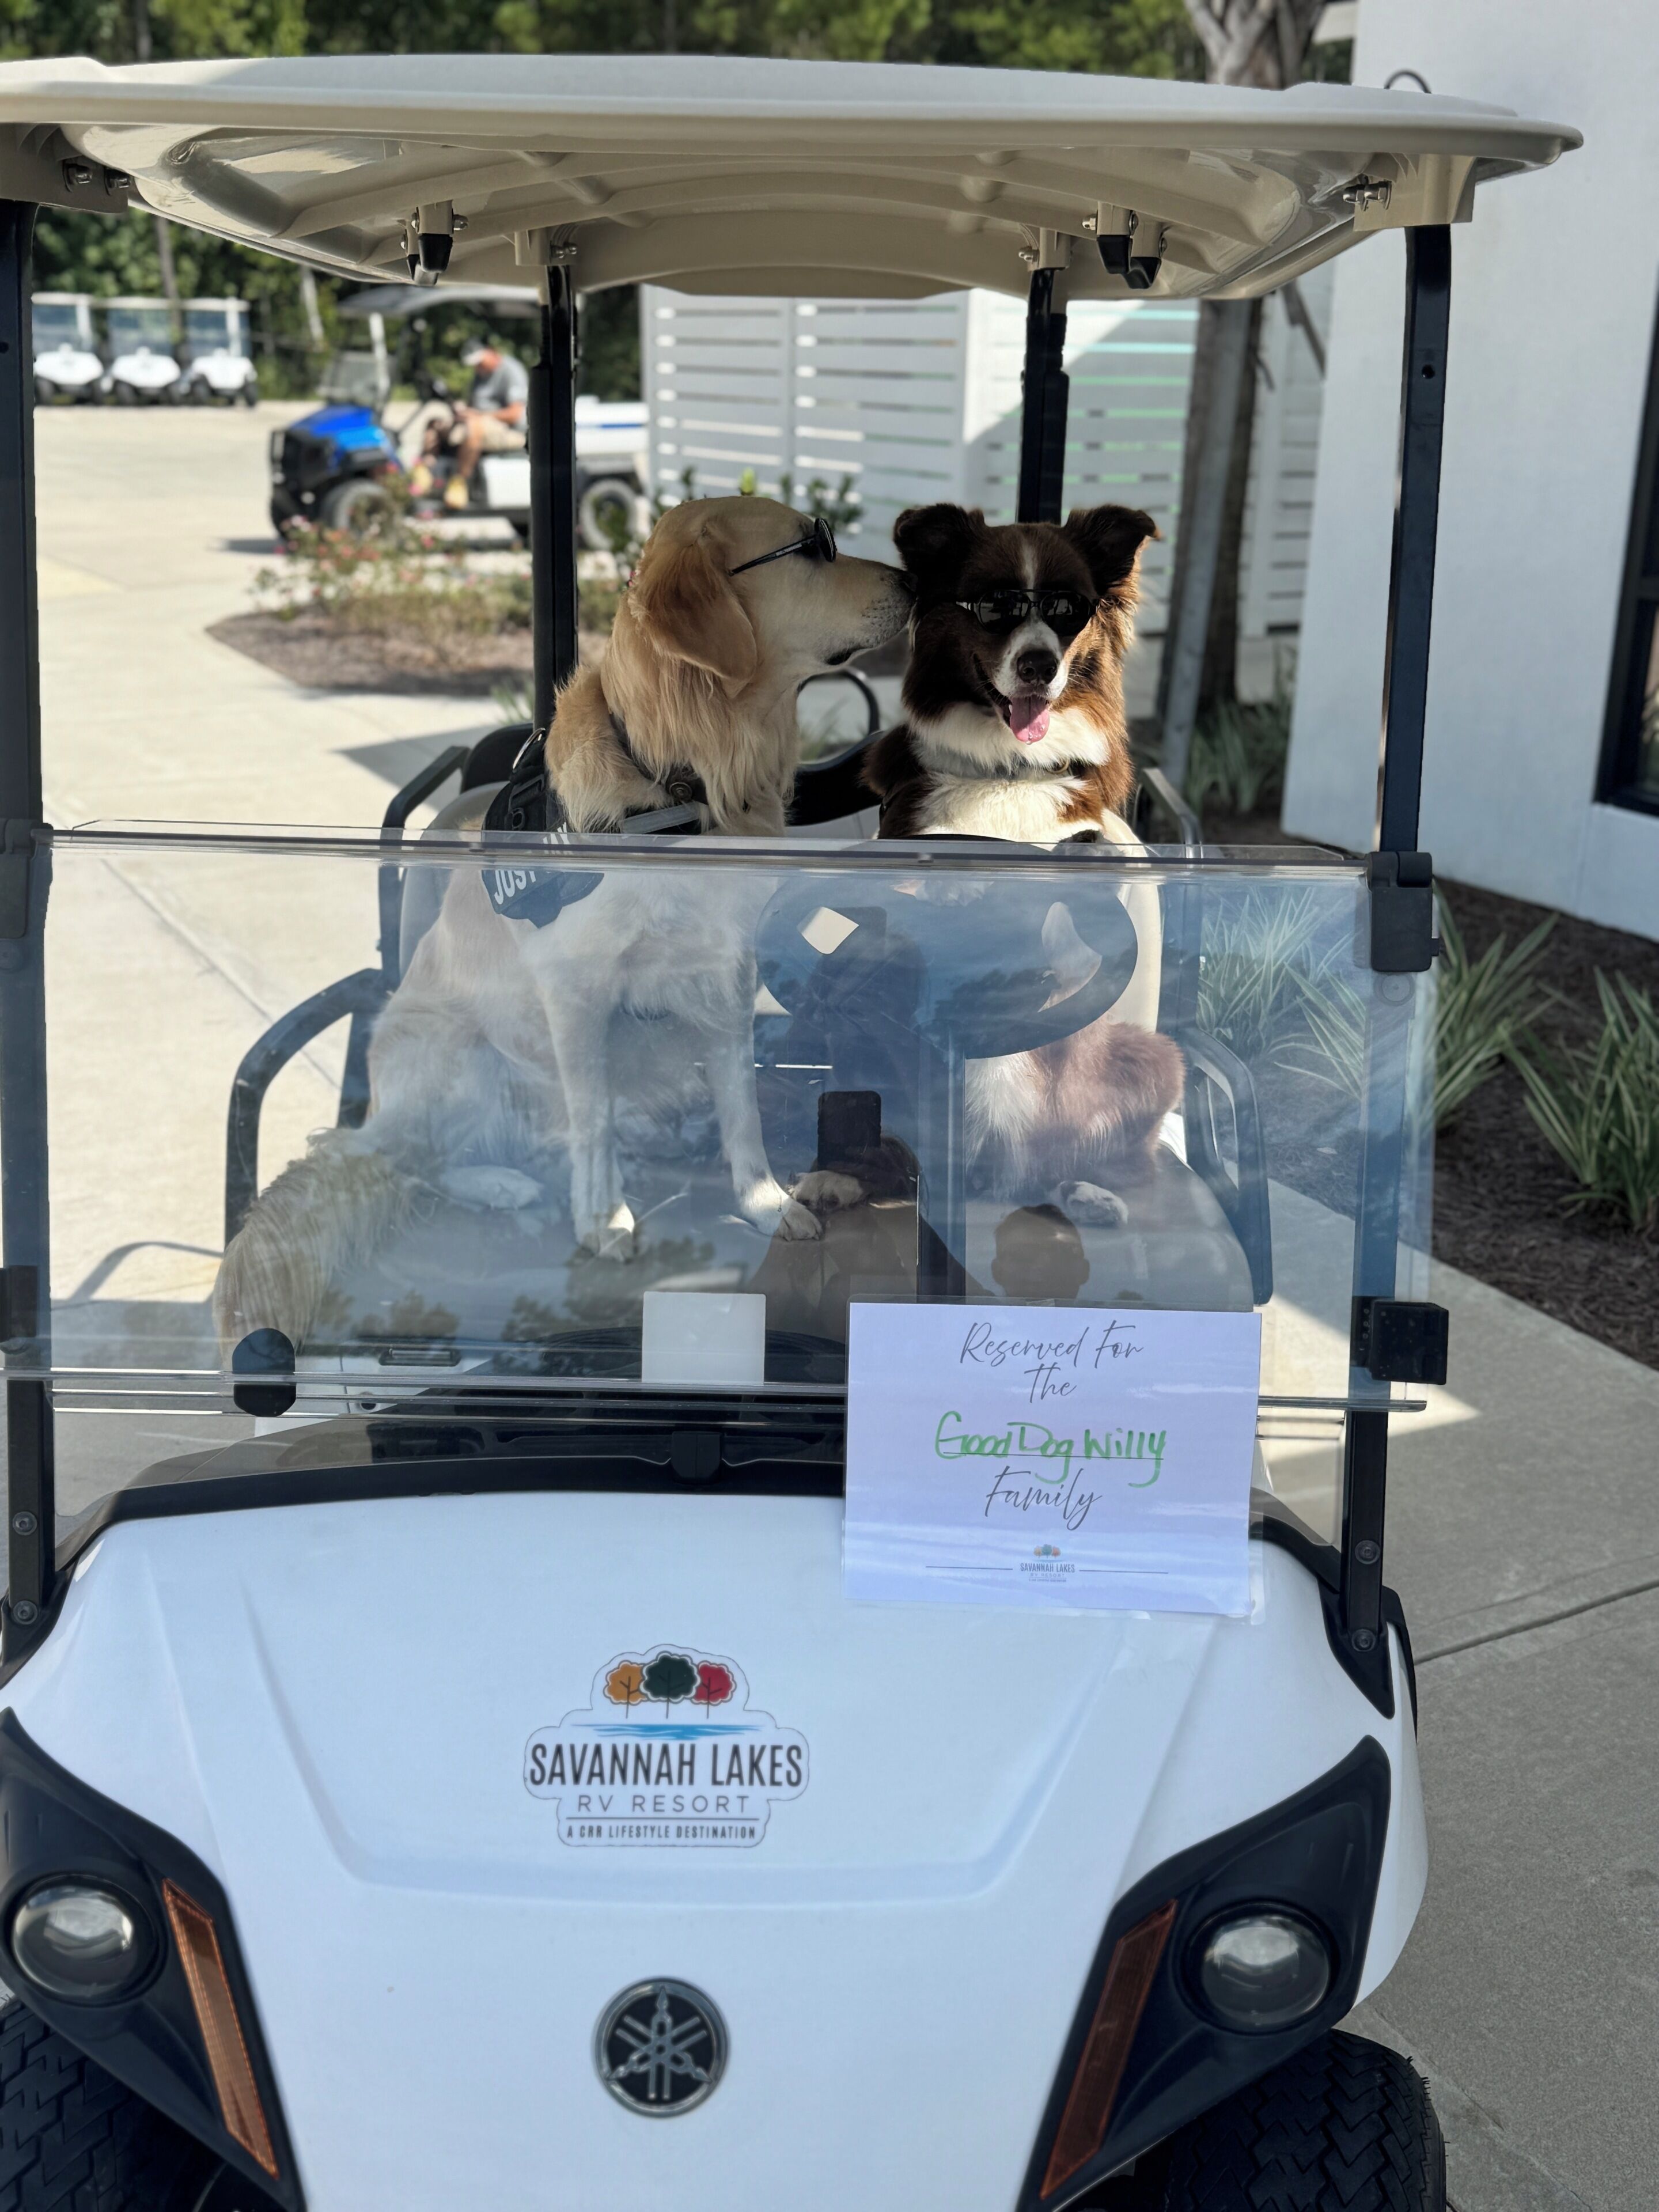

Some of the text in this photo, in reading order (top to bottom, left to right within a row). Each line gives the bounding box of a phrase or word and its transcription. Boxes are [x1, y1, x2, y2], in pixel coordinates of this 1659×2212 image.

[960, 1320, 1145, 1369] Reserved For
[935, 1411, 1013, 1460] Good
[1007, 1422, 1074, 1484] Dog
[984, 1465, 1103, 1531] Family
[1020, 1563, 1075, 1573] SAVANNAH LAKES
[530, 1743, 802, 1787] SAVANNAH LAKES
[577, 1794, 750, 1813] RV RESORT
[567, 1825, 756, 1840] A CRR LIFESTYLE DESTINATION
